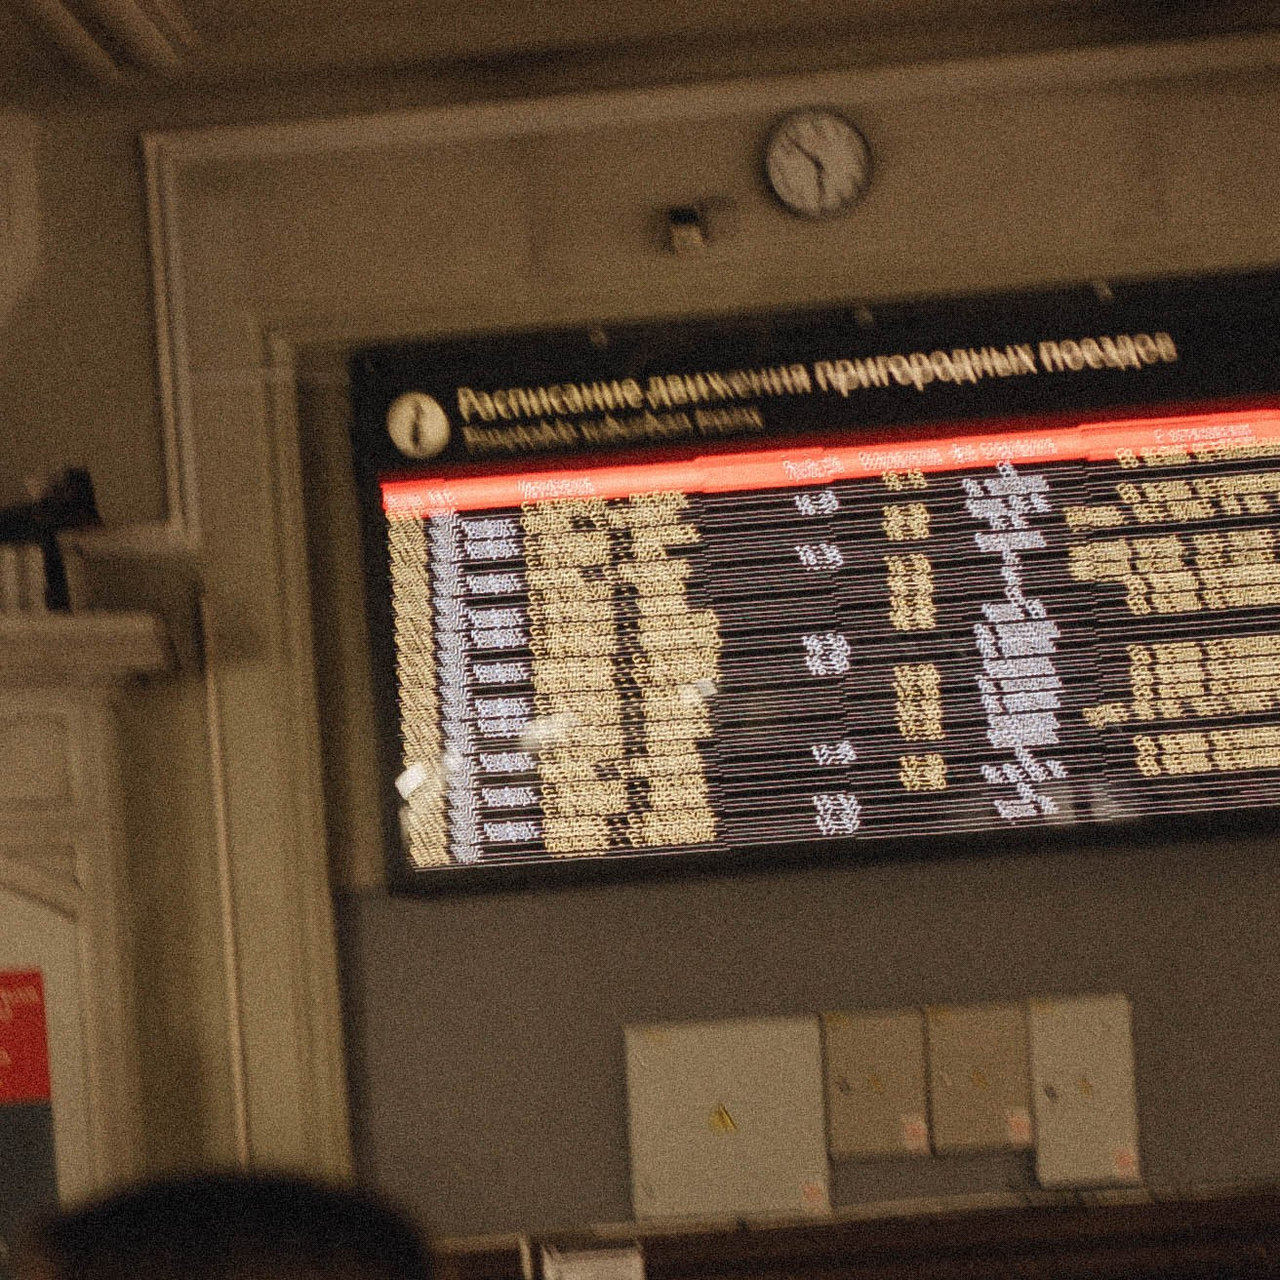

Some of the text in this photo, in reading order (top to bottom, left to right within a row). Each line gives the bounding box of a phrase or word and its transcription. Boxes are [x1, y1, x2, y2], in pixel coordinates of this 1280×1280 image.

[458, 331, 1178, 421] Расписание движения пригородных поездов
